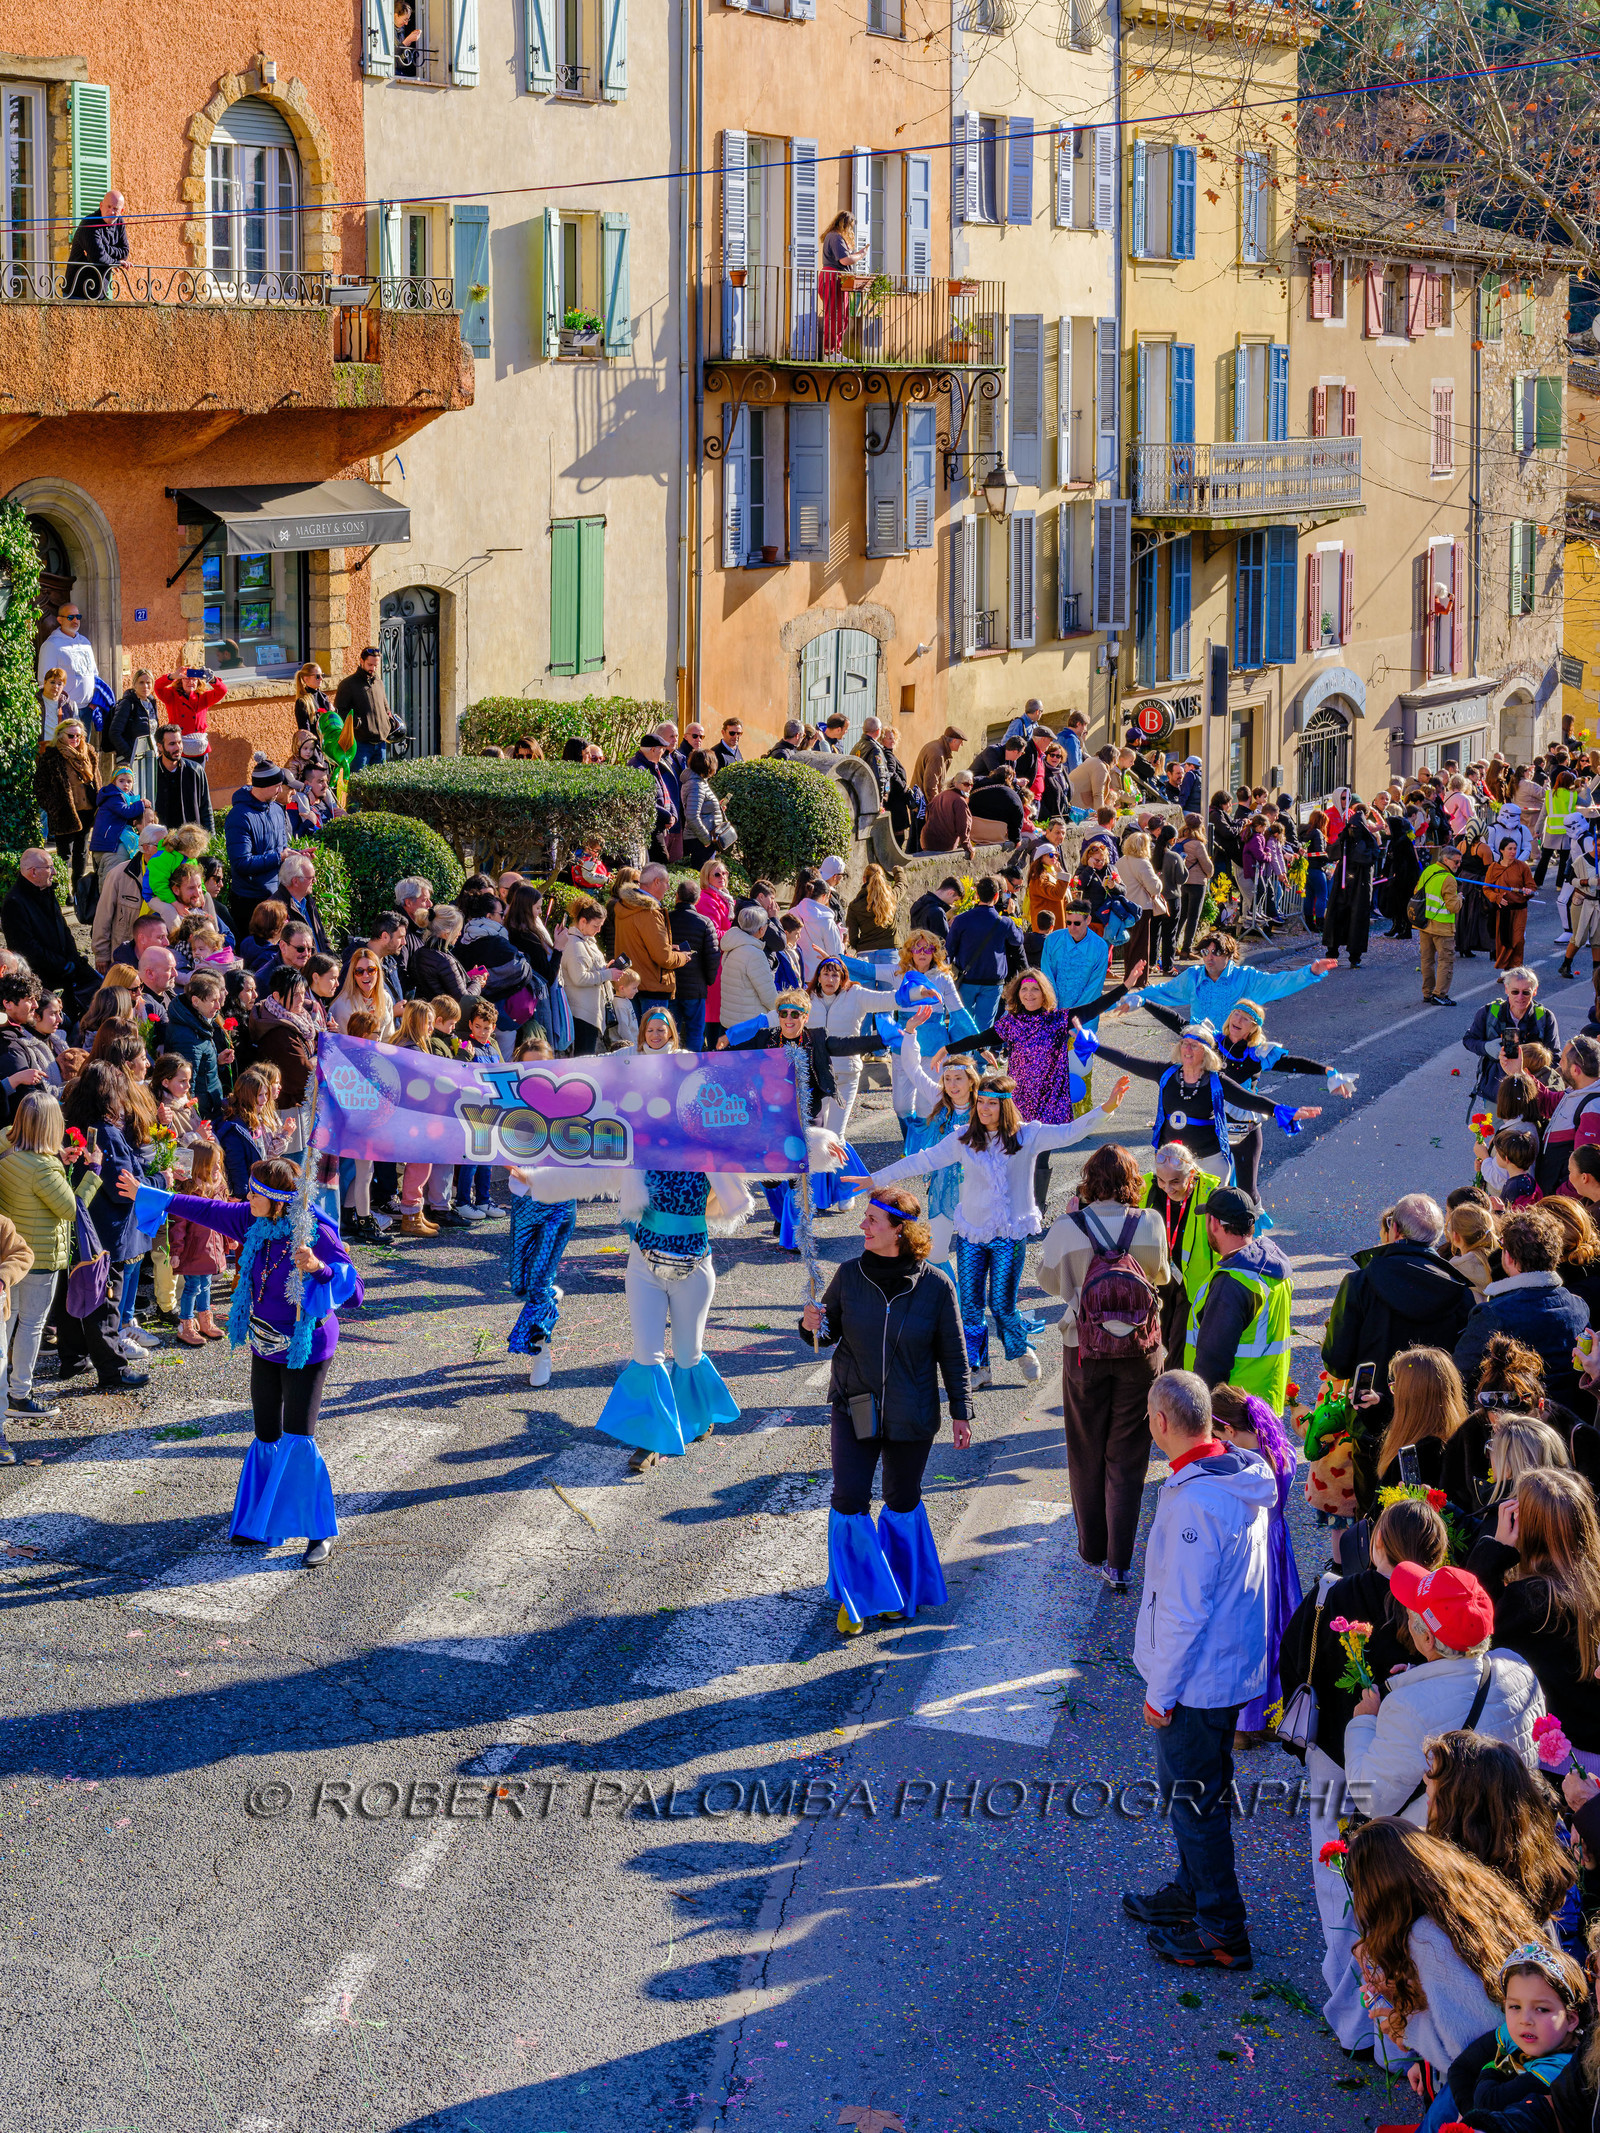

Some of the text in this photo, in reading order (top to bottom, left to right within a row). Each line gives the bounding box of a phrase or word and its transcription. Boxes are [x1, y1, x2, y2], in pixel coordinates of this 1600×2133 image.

[295, 521, 365, 537] MAGREY & SONS
[1139, 701, 1165, 713] BARNES
[1467, 706, 1477, 721] CO
[1145, 711, 1159, 730] B
[356, 1081, 378, 1094] air
[479, 1069, 530, 1109] I
[337, 1093, 377, 1107] Libre
[725, 1097, 746, 1110] air
[704, 1110, 747, 1125] Libre
[460, 1104, 628, 1160] YOGA
